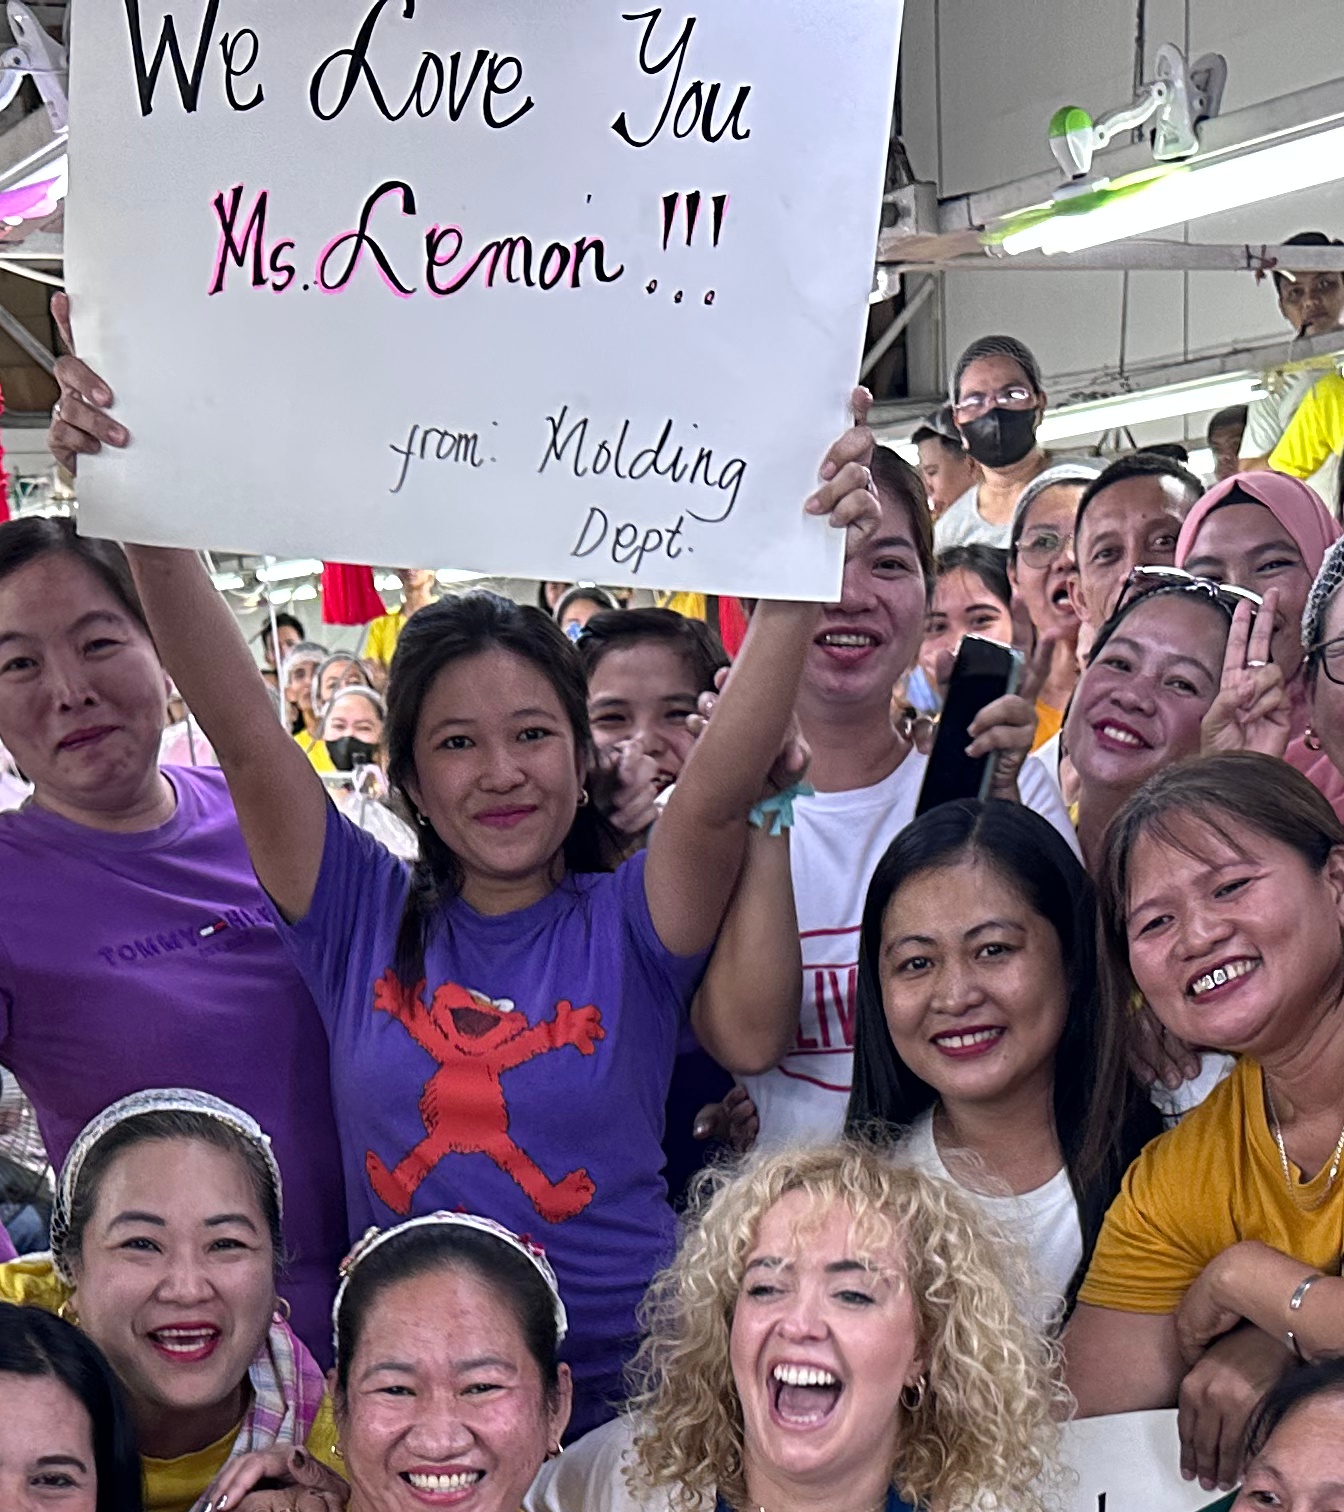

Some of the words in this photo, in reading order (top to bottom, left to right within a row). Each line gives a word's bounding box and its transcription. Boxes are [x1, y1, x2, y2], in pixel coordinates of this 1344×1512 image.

[125, 0, 264, 116] We
[309, 0, 535, 128] Love
[611, 8, 751, 147] You
[538, 405, 747, 523] Molding
[570, 507, 694, 573] Dept.
[98, 927, 197, 966] TOMMY
